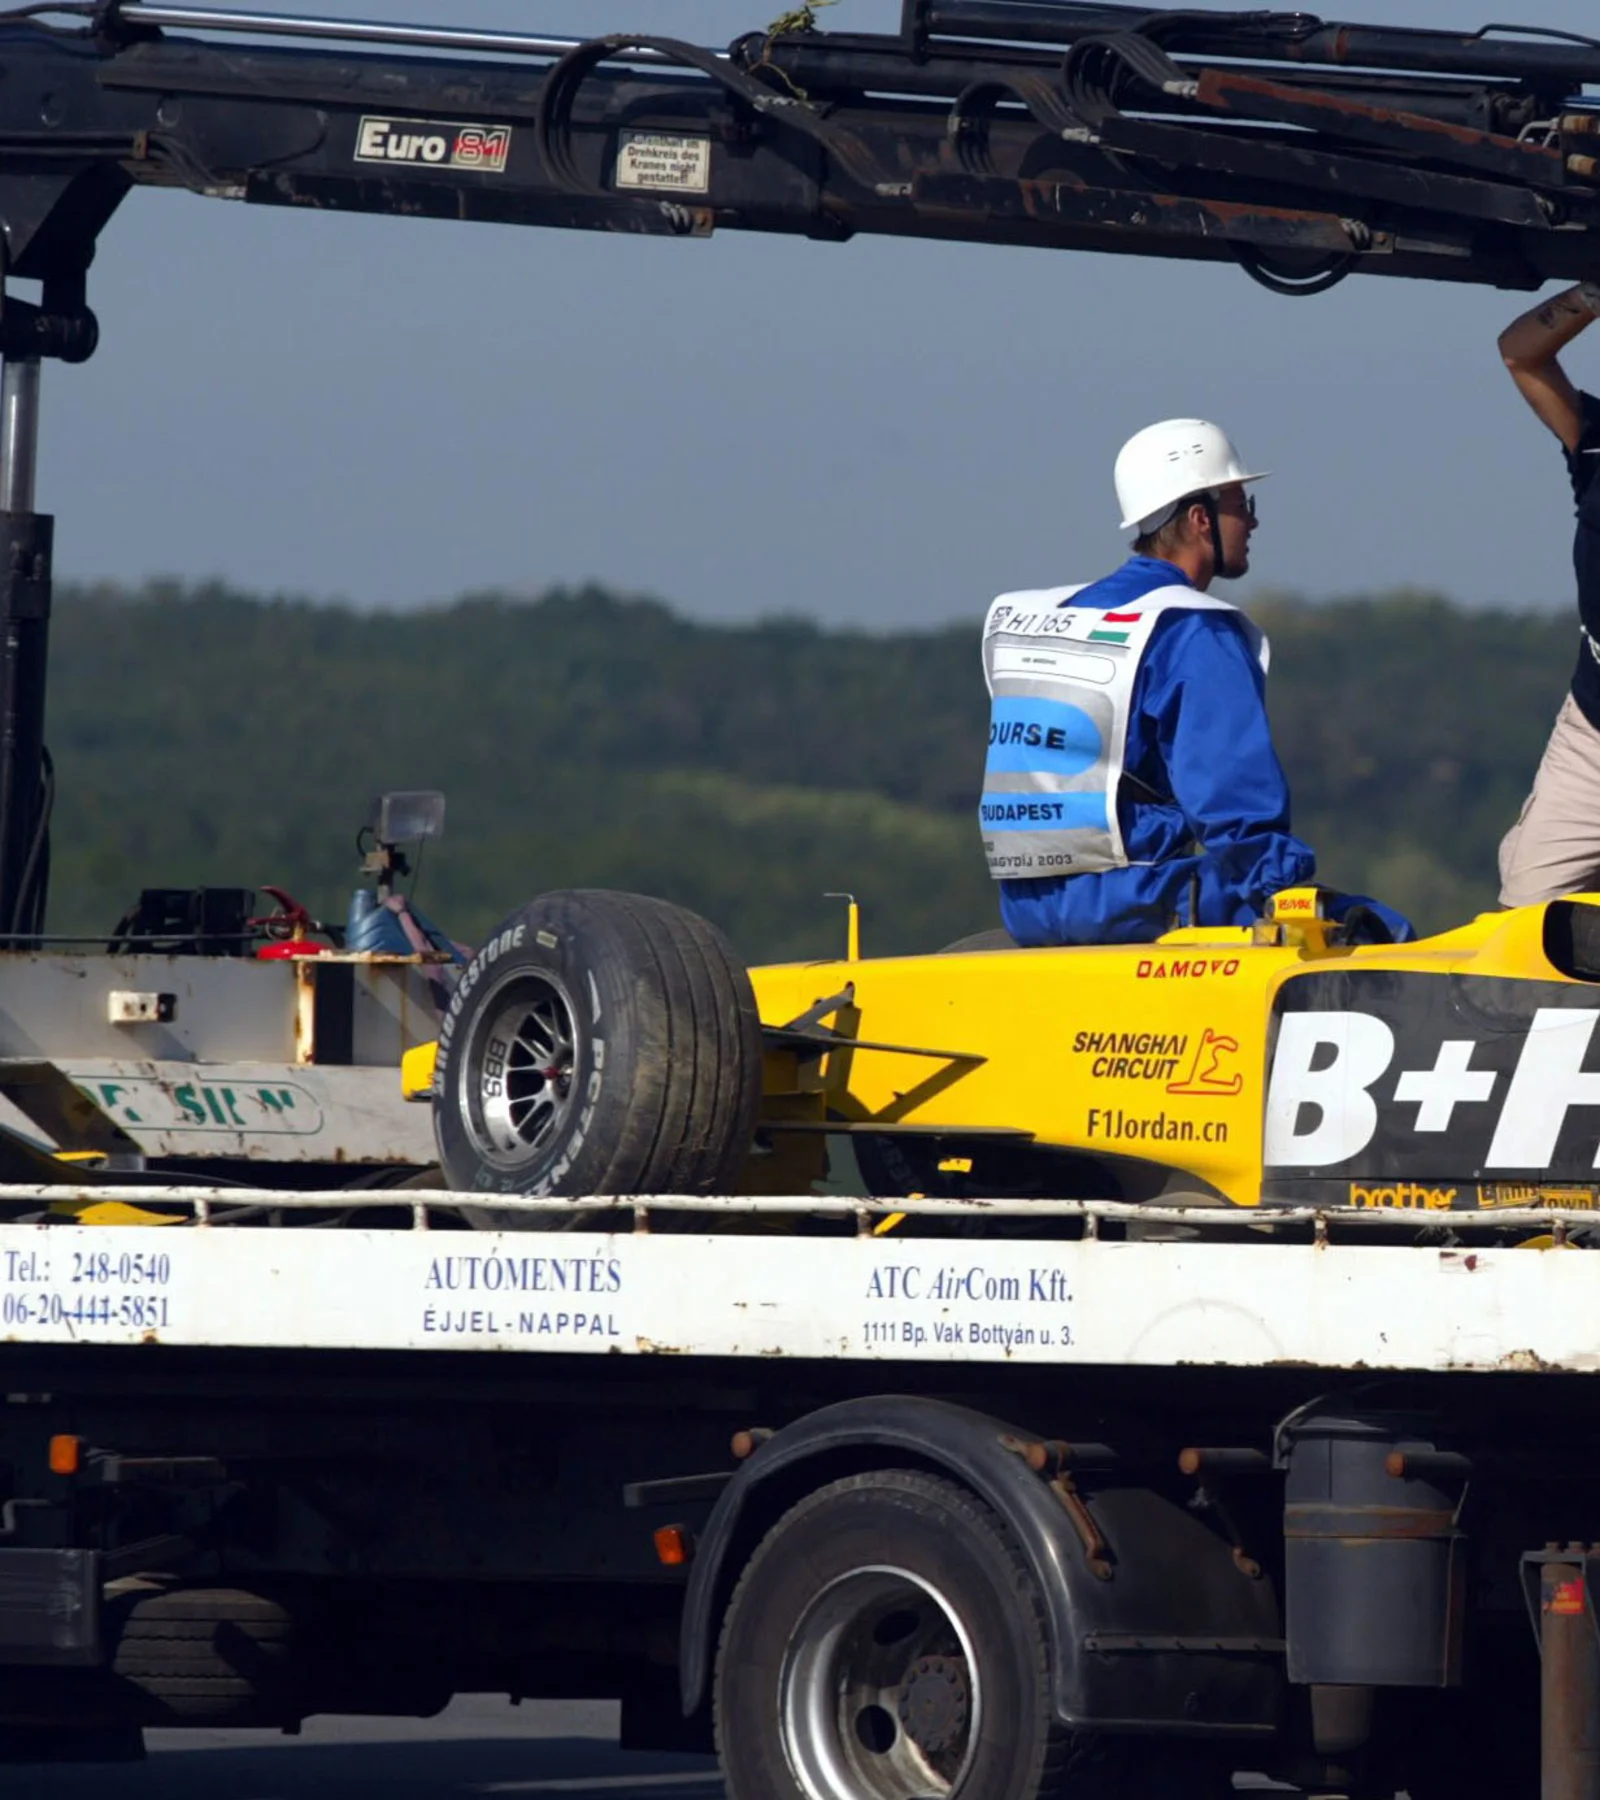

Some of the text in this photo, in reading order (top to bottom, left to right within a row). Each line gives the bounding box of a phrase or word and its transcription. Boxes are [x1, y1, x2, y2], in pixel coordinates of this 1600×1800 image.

[360, 121, 506, 167] Euro 81
[981, 803, 1065, 822] BUDAPEST
[1037, 853, 1074, 867] 2003
[1136, 959, 1241, 979] DAMOVO
[1072, 1030, 1188, 1056] SHANGHAI
[1090, 1056, 1180, 1081] CIRCUIT
[1086, 1107, 1229, 1143] F1Jordan.cn
[1349, 1182, 1457, 1210] brother
[4, 1250, 171, 1286] Tel.: 248-0540
[424, 1246, 622, 1293] AUTÓMENTÉS
[865, 1265, 1074, 1302] ATC AirCom Kft.
[863, 1321, 1075, 1349] 1111 Bp. Vak Bottyán u. 3.
